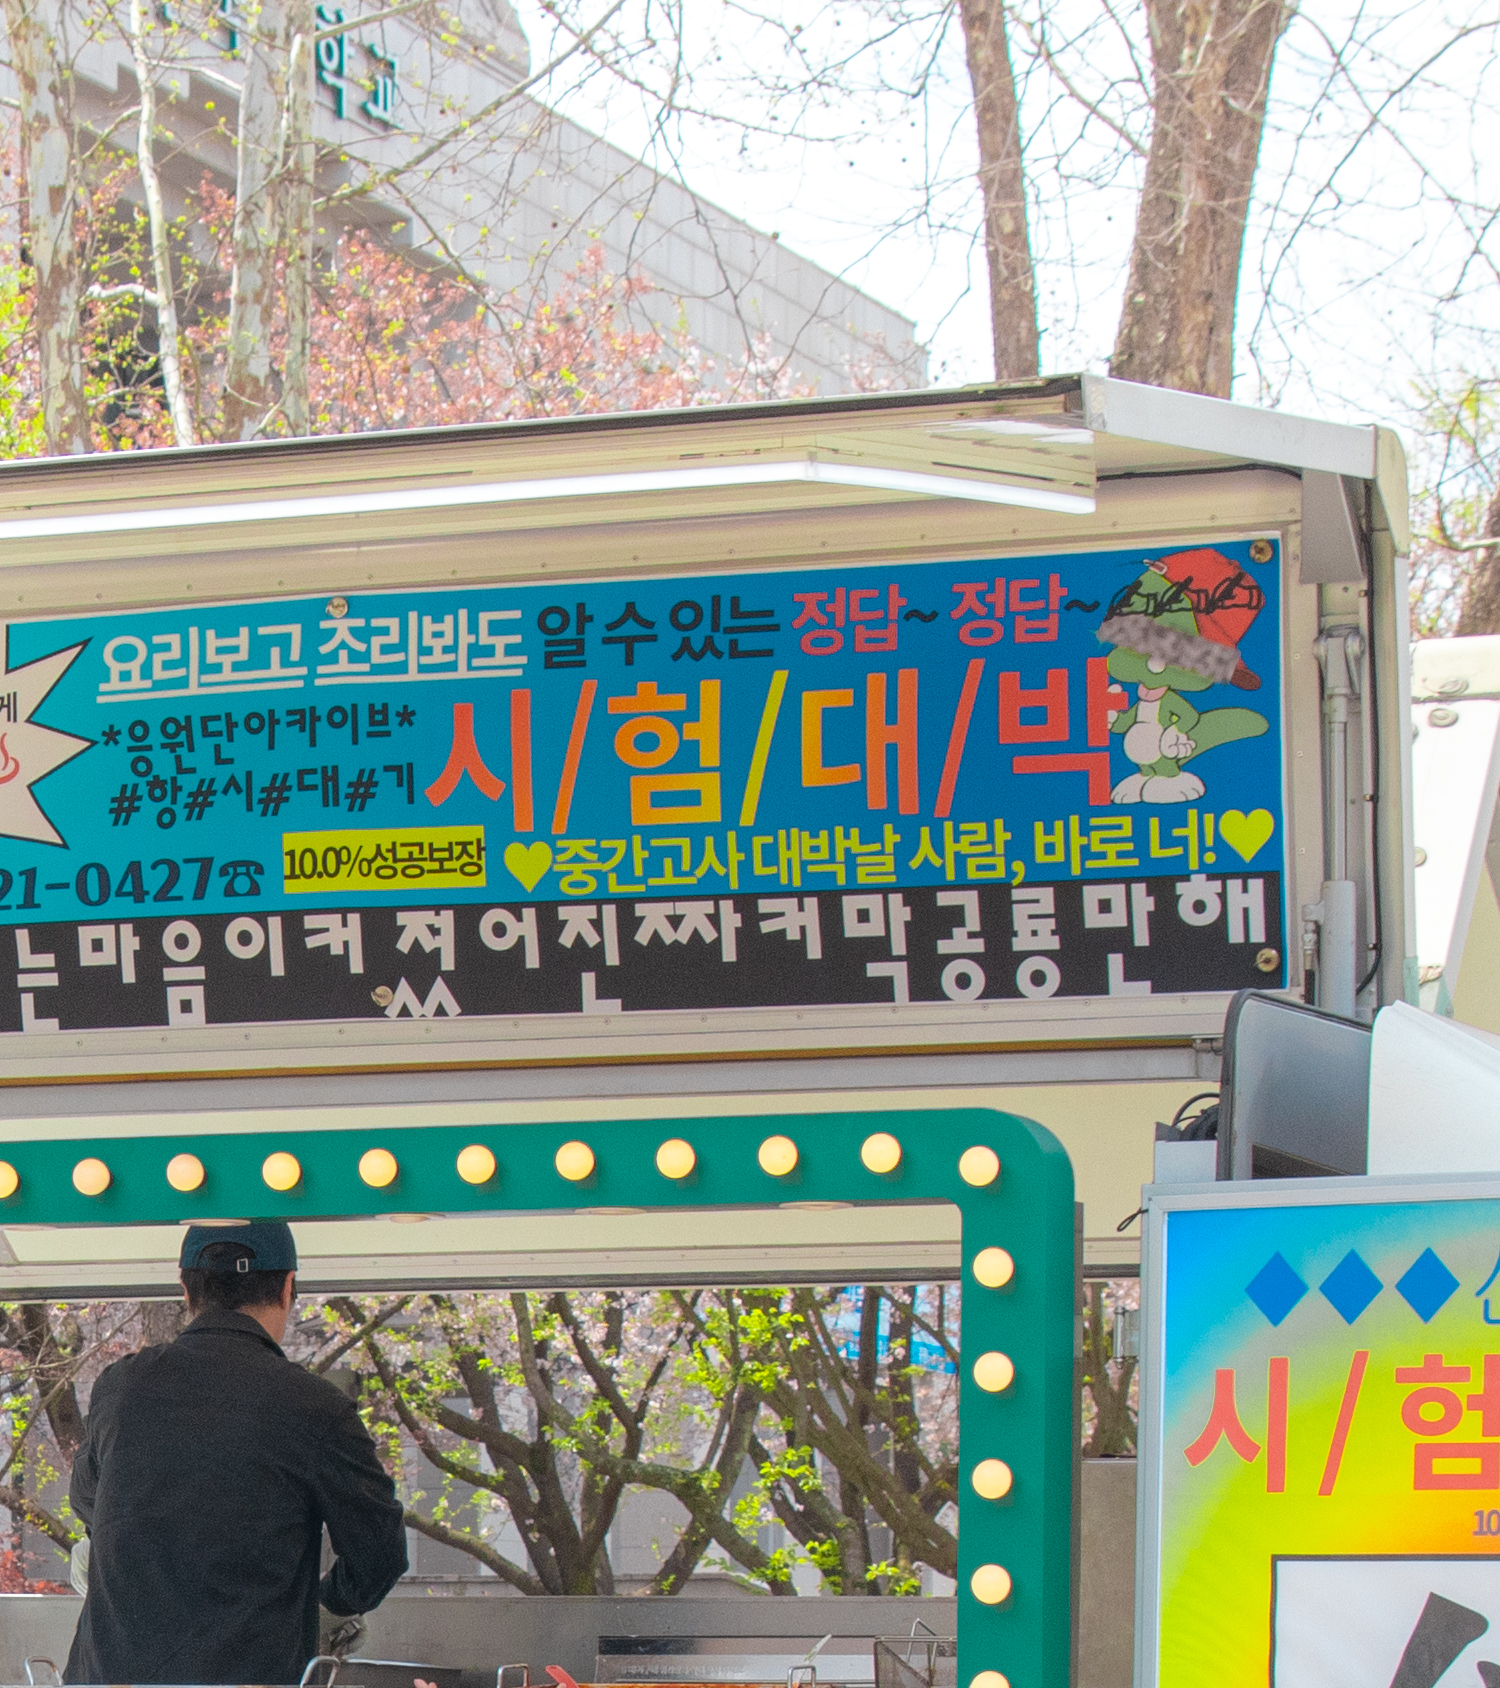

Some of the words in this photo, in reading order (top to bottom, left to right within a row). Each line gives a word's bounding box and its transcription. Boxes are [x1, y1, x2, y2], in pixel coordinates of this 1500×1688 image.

[98, 623, 308, 694] 요리보고
[316, 608, 528, 678] 조리봐도
[425, 655, 1128, 836] 시/험/대/박
[551, 835, 746, 896] 중간고사
[752, 823, 902, 887] 대박날
[909, 818, 1028, 887] 사람,
[1034, 812, 1141, 877] 바로
[1148, 807, 1219, 865] 너!
